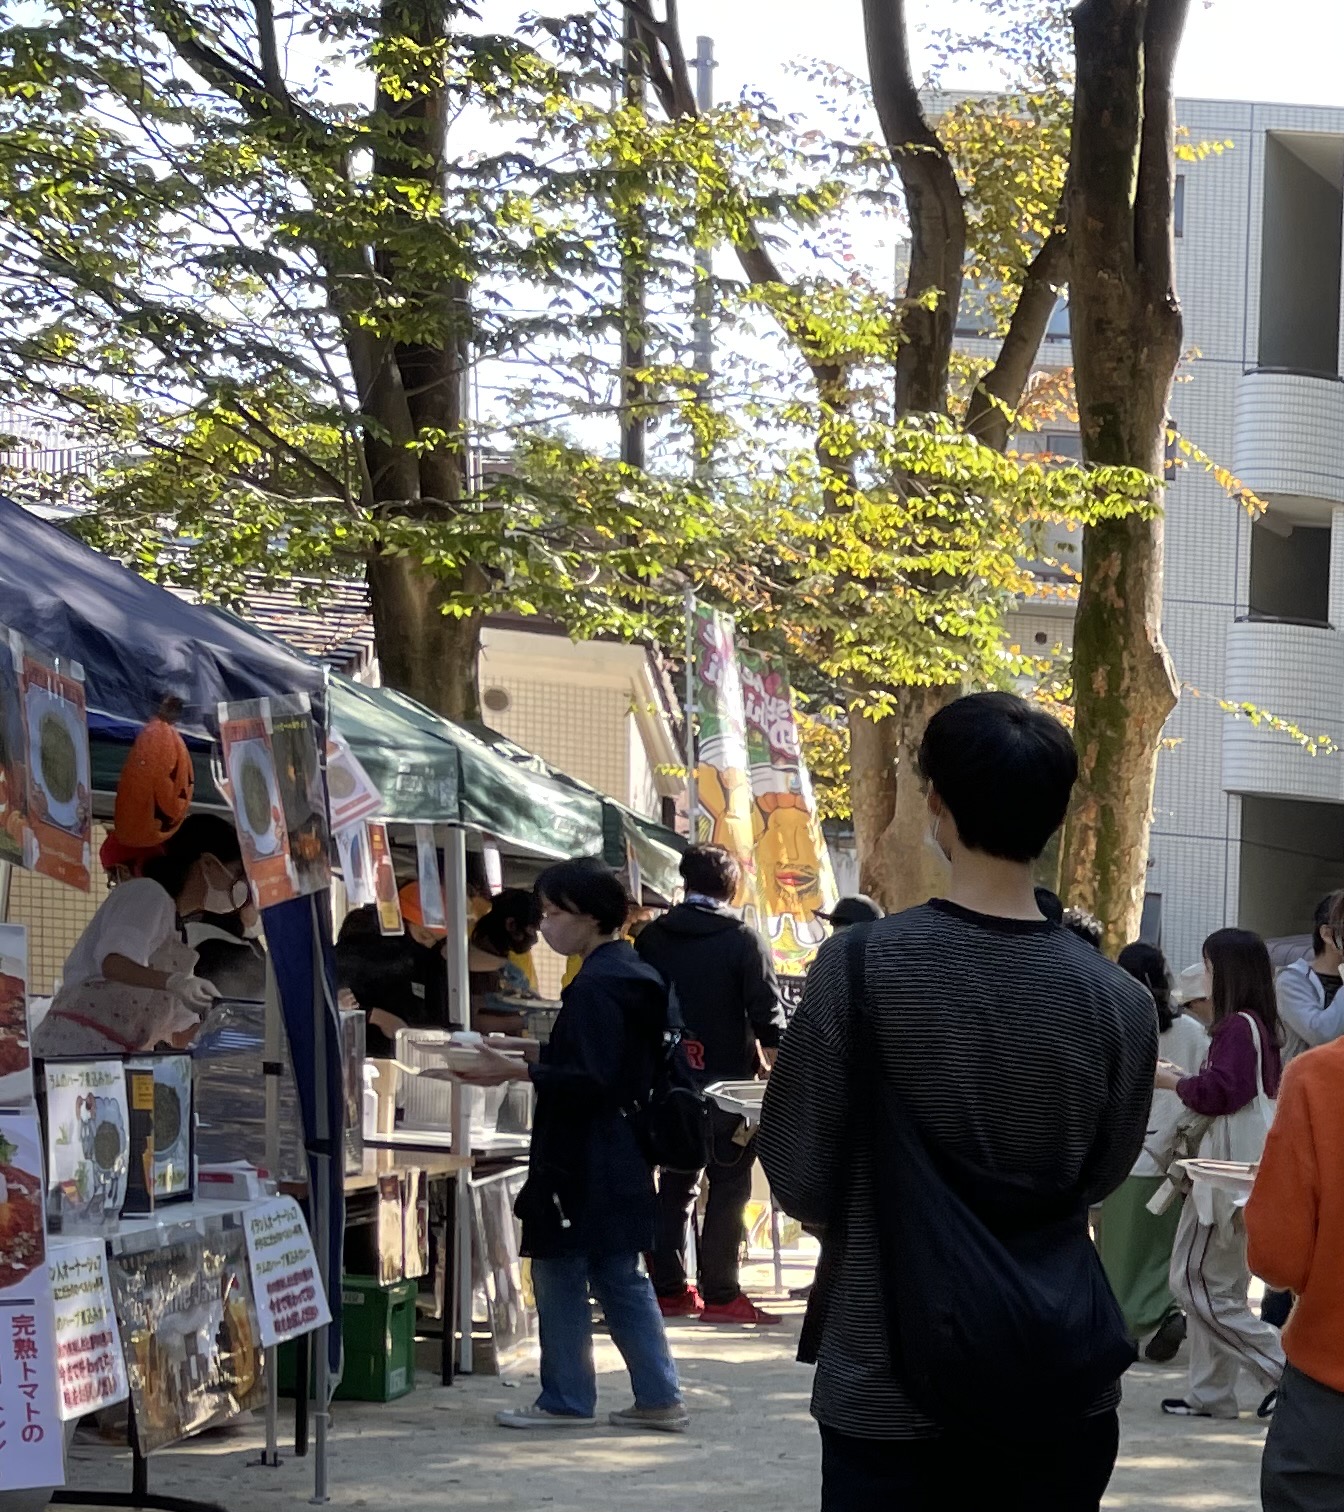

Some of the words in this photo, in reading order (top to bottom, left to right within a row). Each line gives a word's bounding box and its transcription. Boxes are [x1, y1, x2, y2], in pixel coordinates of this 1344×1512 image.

[682, 1039, 705, 1070] R
[11, 1314, 45, 1443] 完熟トマトの
